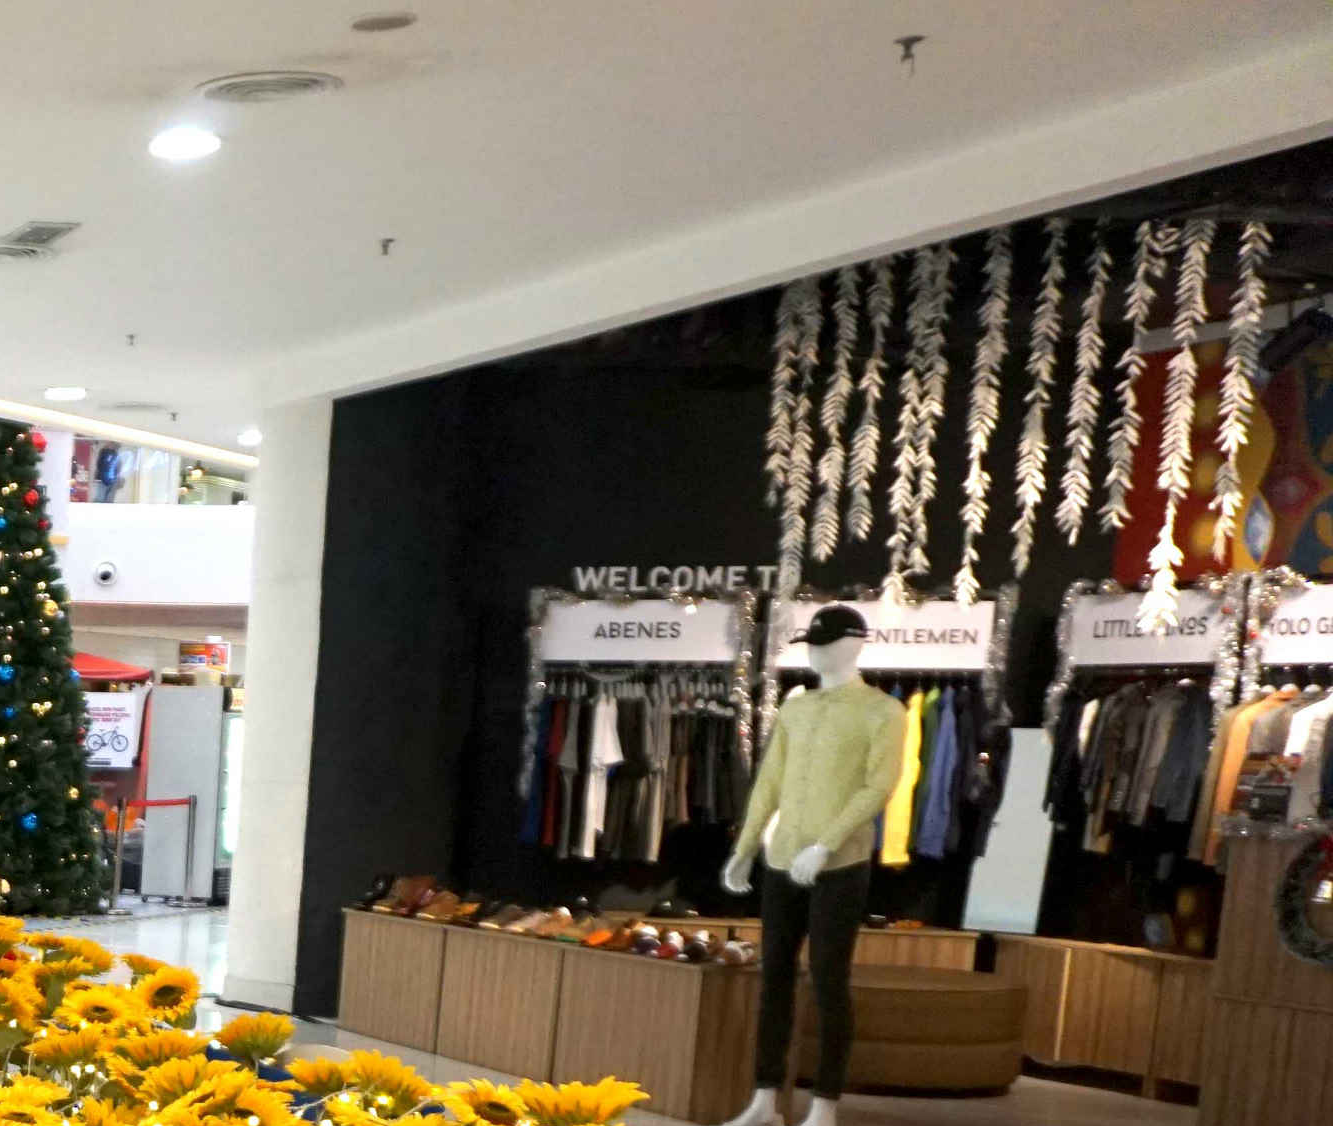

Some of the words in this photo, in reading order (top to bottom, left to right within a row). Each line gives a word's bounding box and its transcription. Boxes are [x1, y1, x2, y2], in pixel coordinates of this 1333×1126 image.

[573, 565, 748, 592] WELCOME
[593, 621, 682, 640] ABENES
[1317, 616, 1333, 634] G
[865, 628, 979, 645] ENTLEMEN
